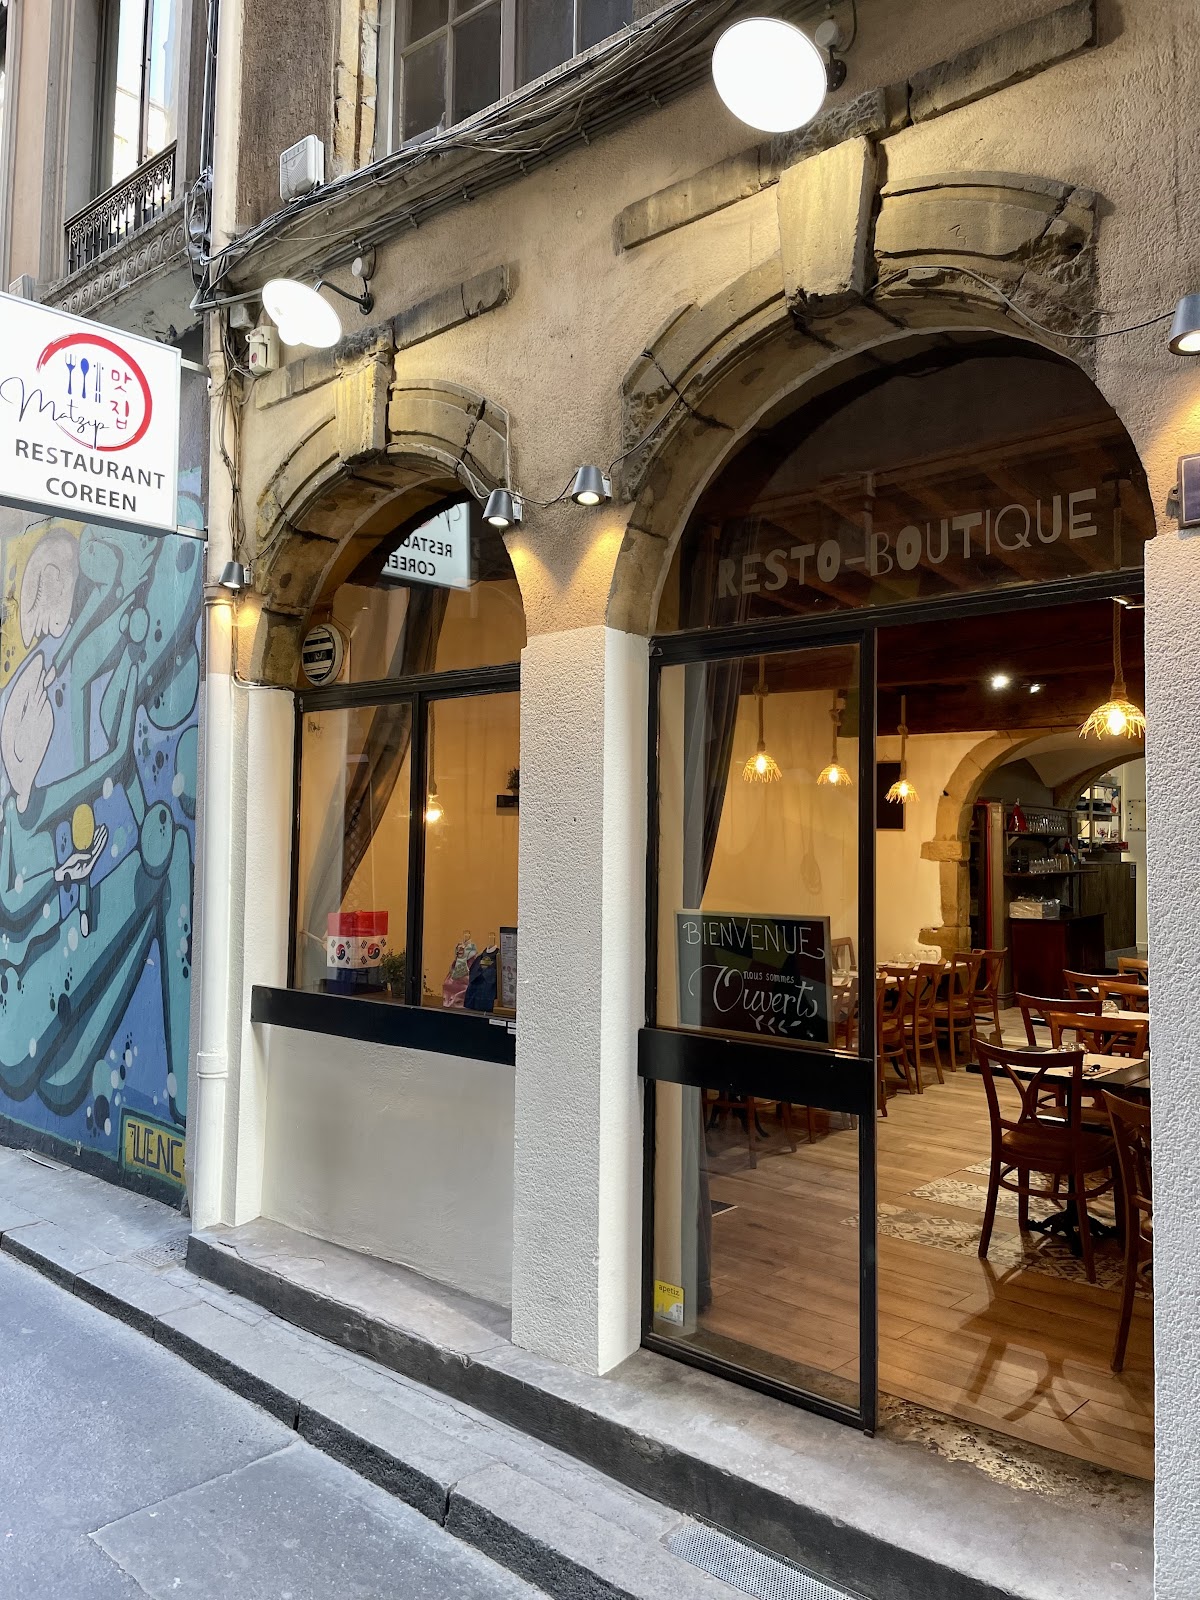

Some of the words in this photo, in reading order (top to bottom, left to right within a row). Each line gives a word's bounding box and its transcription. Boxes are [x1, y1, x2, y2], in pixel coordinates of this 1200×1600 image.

[110, 368, 133, 429] 맛집
[15, 439, 165, 489] RESTAURANT
[45, 477, 137, 512] COREEN
[688, 964, 818, 1018] Ouverts
[743, 970, 763, 981] nous
[765, 973, 795, 984] sommes
[658, 1284, 680, 1296] apetiz
